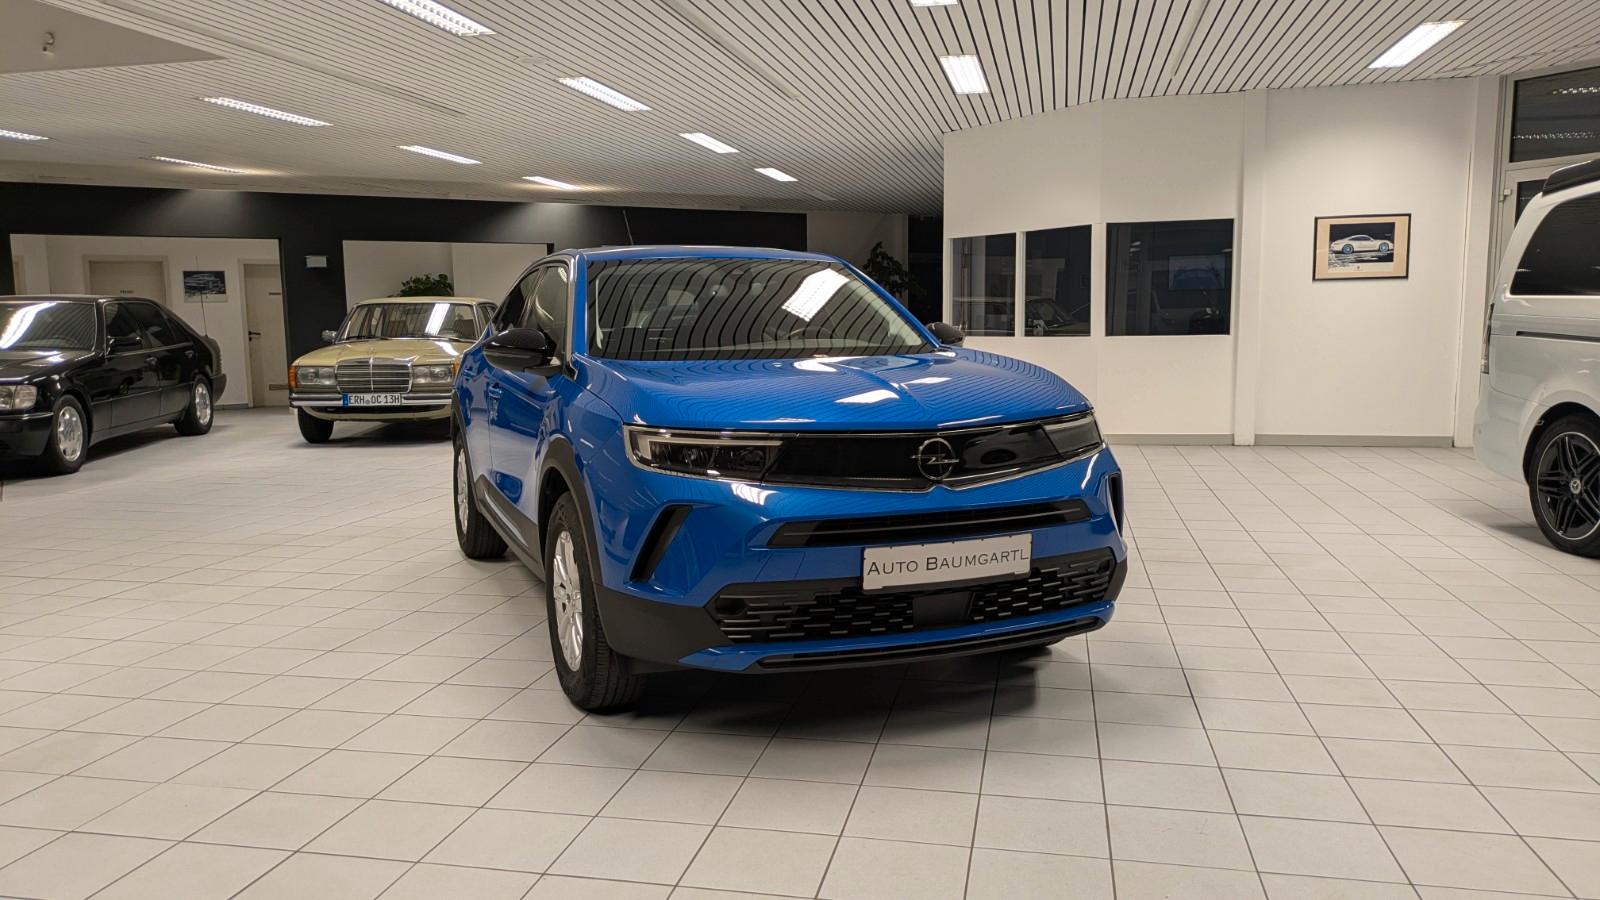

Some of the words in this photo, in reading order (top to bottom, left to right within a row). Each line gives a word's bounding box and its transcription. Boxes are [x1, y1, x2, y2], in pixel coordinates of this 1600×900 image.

[349, 395, 365, 404] ERH
[384, 394, 400, 404] 13H
[867, 561, 919, 575] AUTO
[926, 549, 1029, 571] BAUMGARTL
